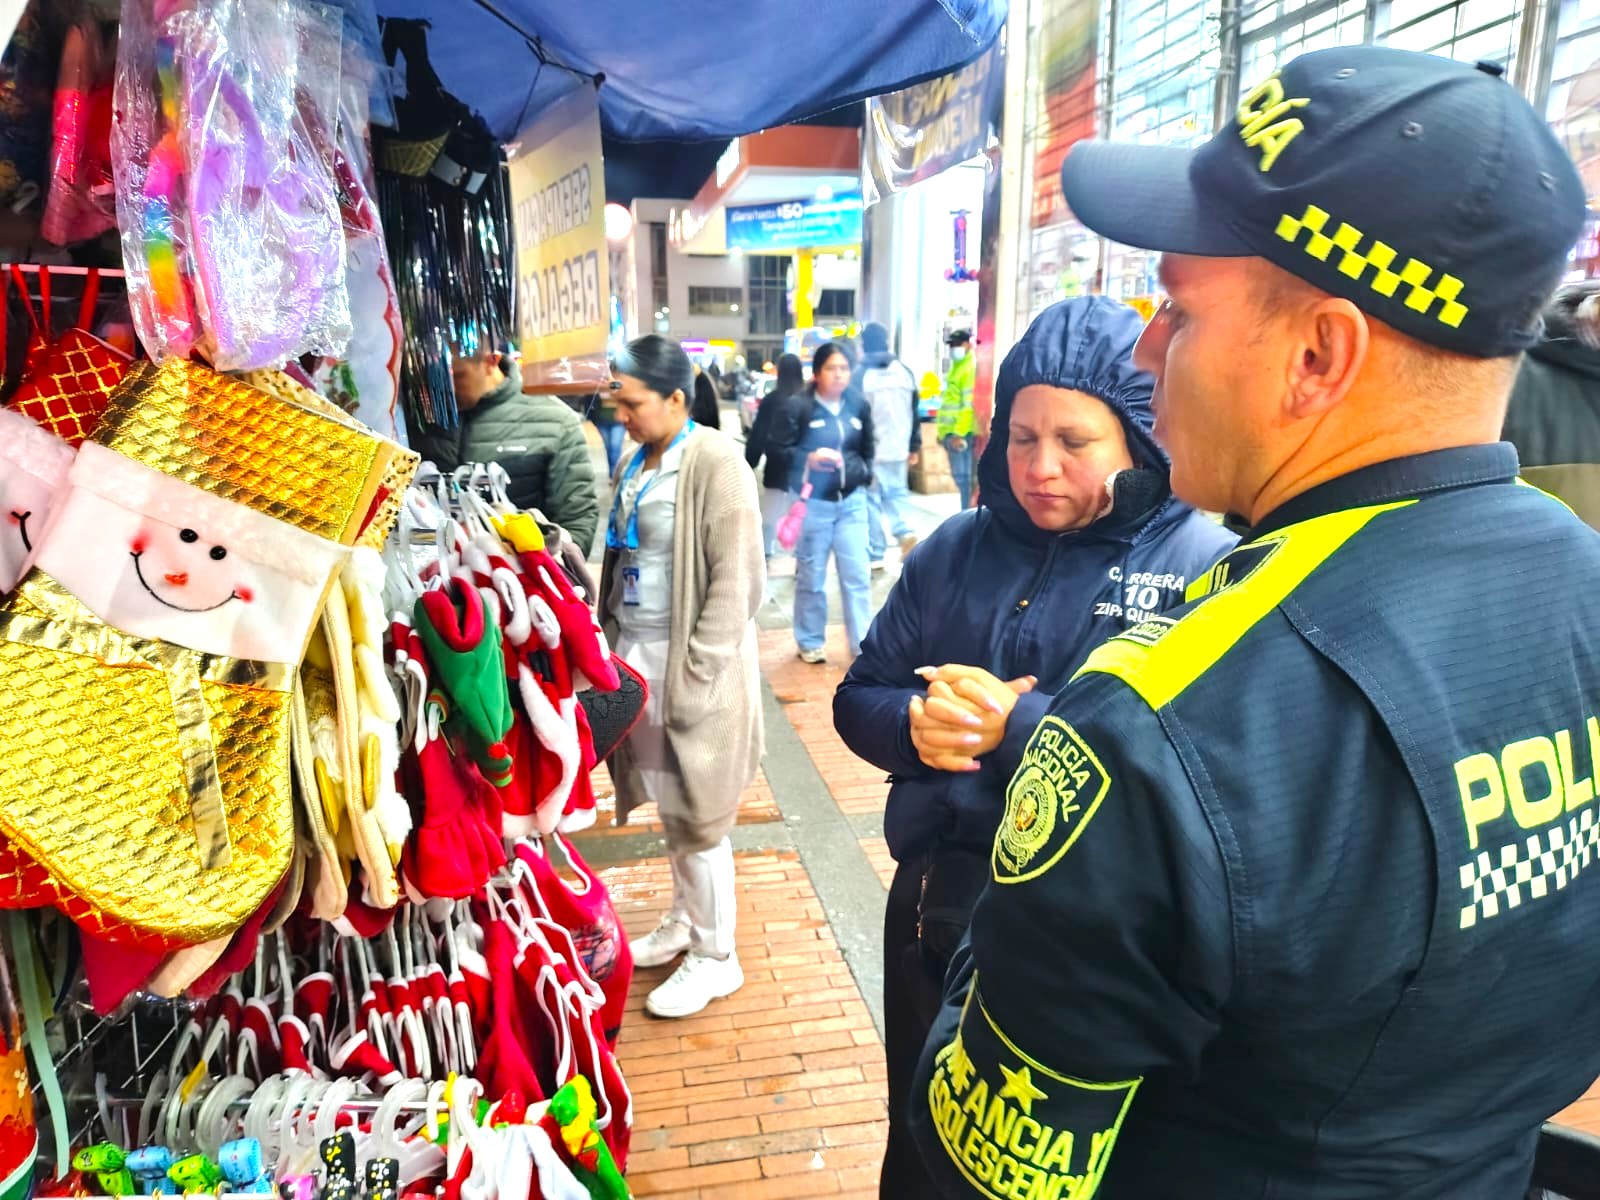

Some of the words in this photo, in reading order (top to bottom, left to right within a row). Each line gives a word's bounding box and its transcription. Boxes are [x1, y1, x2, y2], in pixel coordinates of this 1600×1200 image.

[1125, 584, 1160, 610] 10
[1024, 748, 1081, 823] NACIONAL
[1038, 729, 1091, 790] POLICÍA
[935, 1036, 1074, 1174] FANCIA
